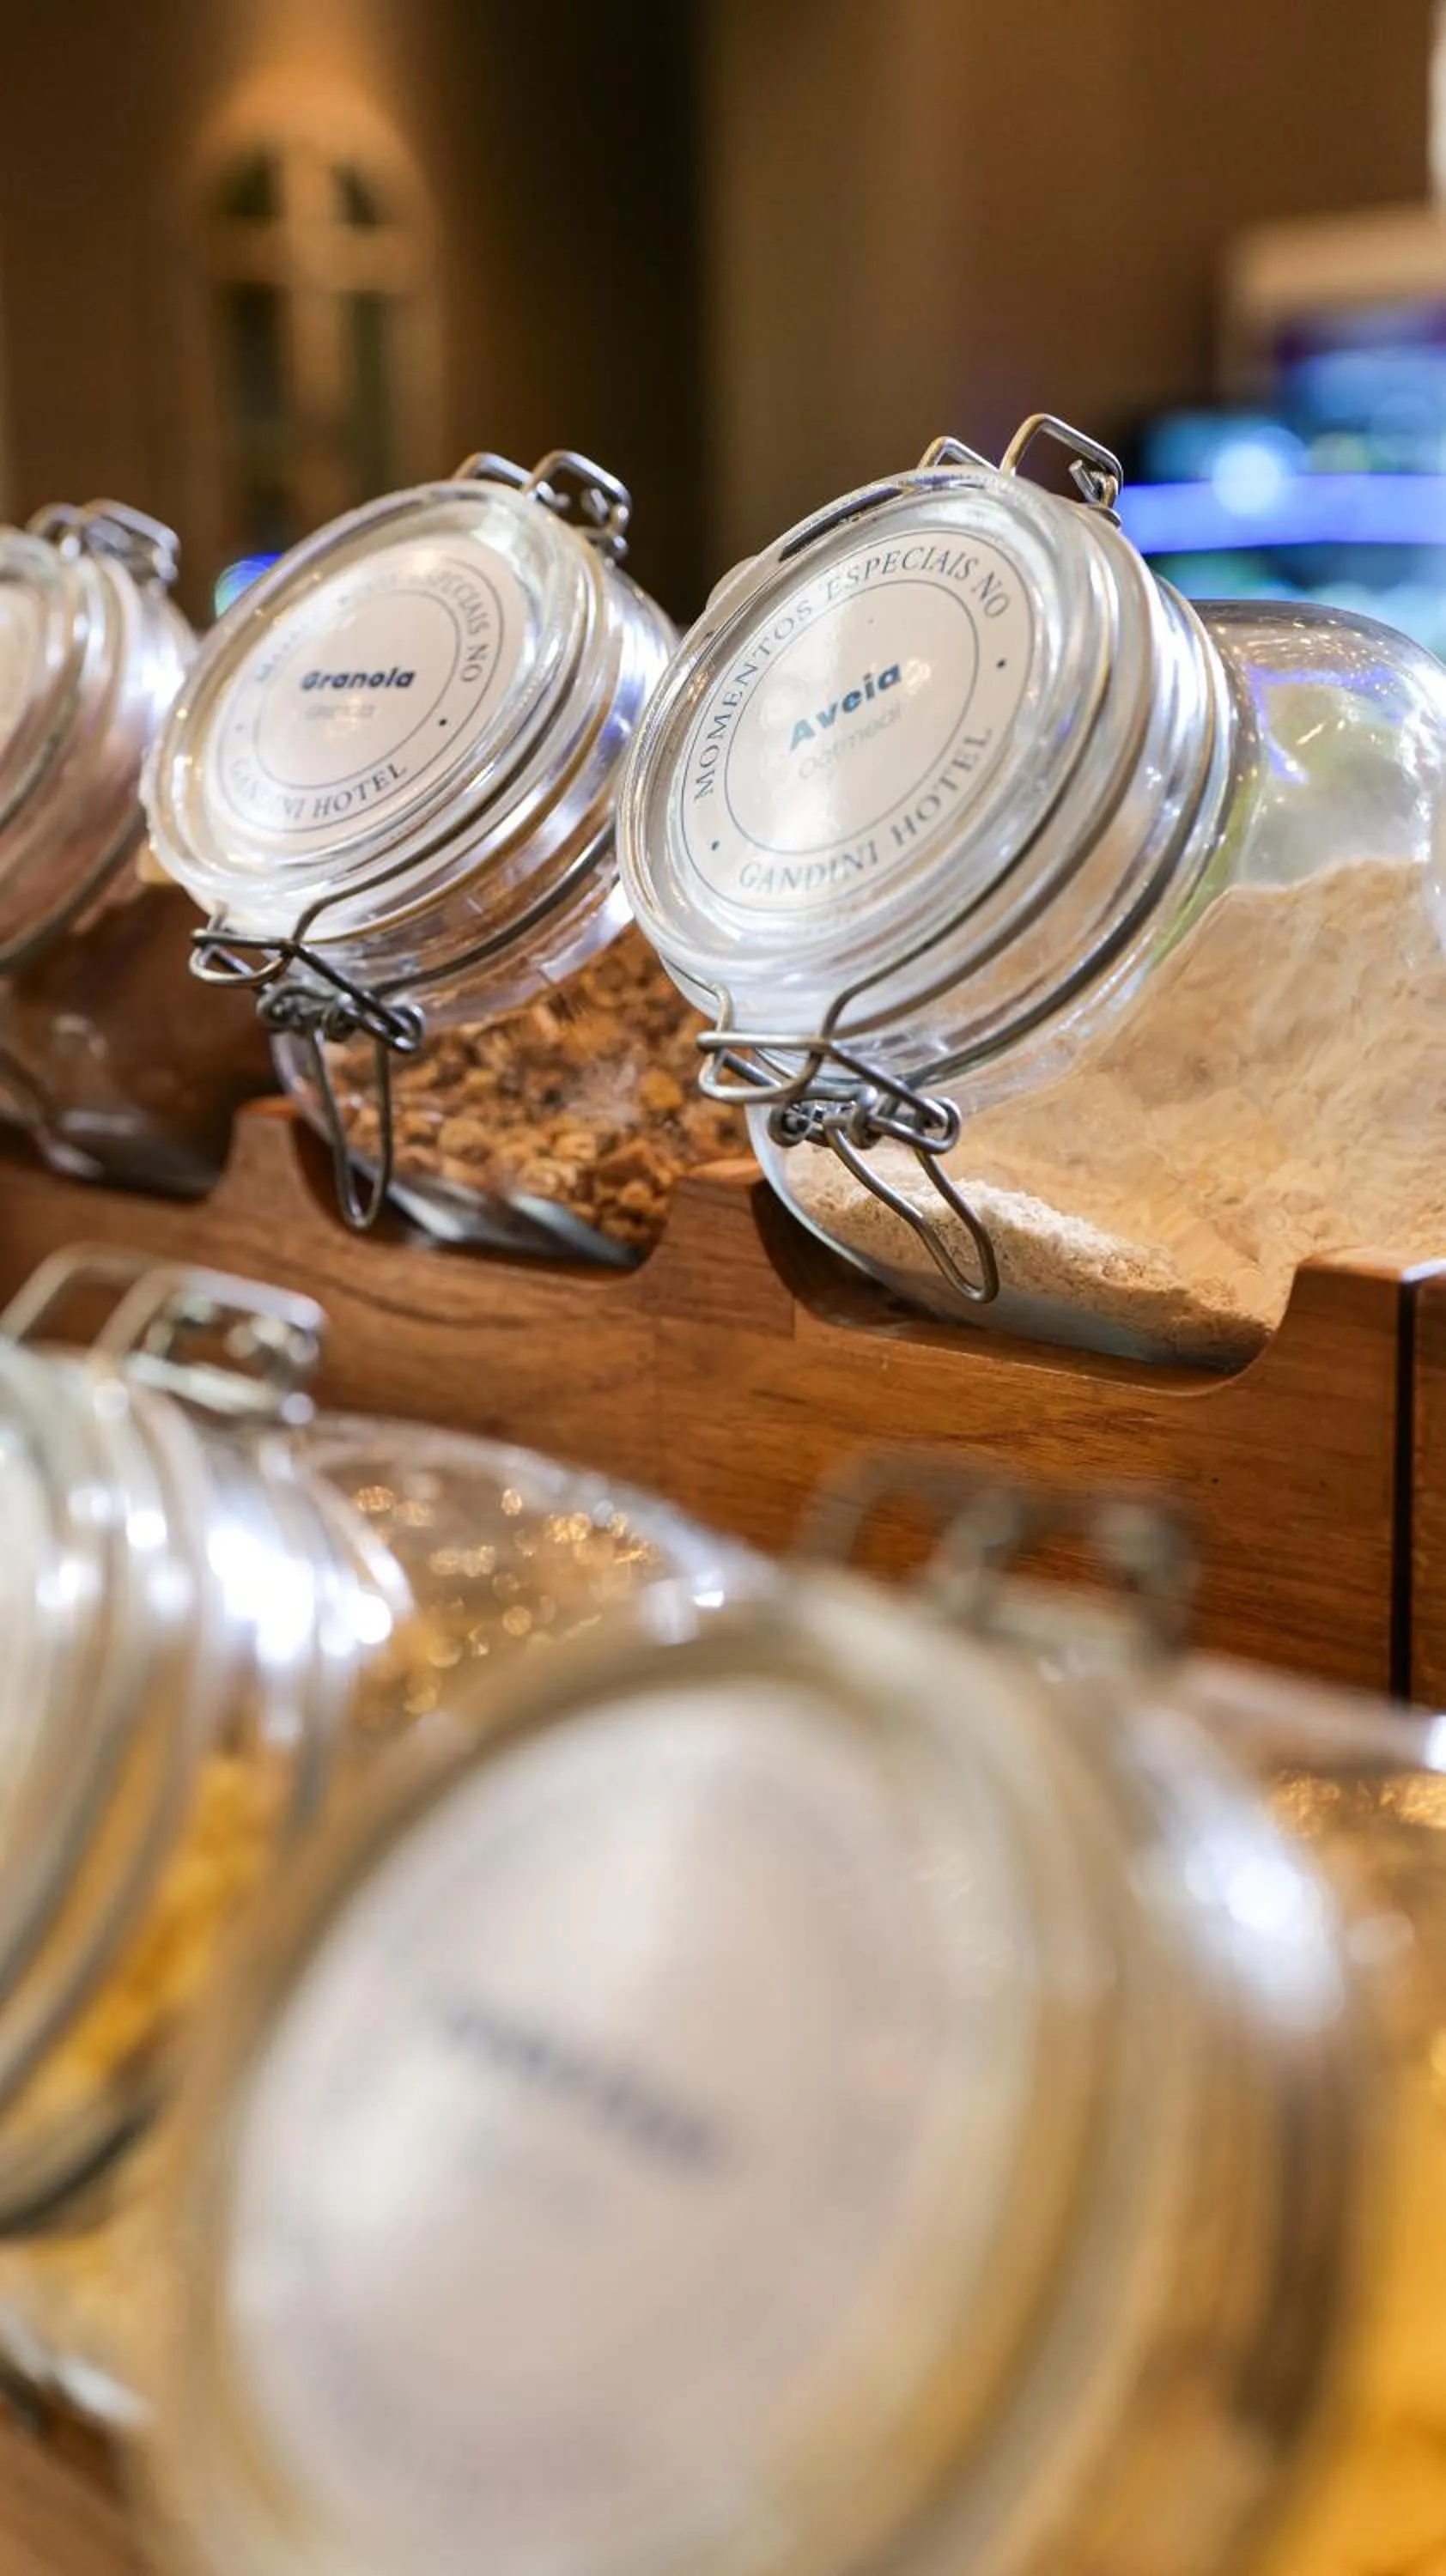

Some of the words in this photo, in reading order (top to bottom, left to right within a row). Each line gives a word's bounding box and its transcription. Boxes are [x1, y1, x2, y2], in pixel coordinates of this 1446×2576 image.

[301, 666, 416, 691] Granola
[460, 642, 489, 683] NO
[694, 598, 813, 804] MOMENTOS
[825, 546, 979, 601] ESPECIAIS
[970, 571, 1011, 619] NO
[788, 662, 903, 752] Aveia
[312, 762, 409, 818] HOTEL
[739, 840, 880, 893] GANDINI
[889, 726, 993, 848] HOTEL
